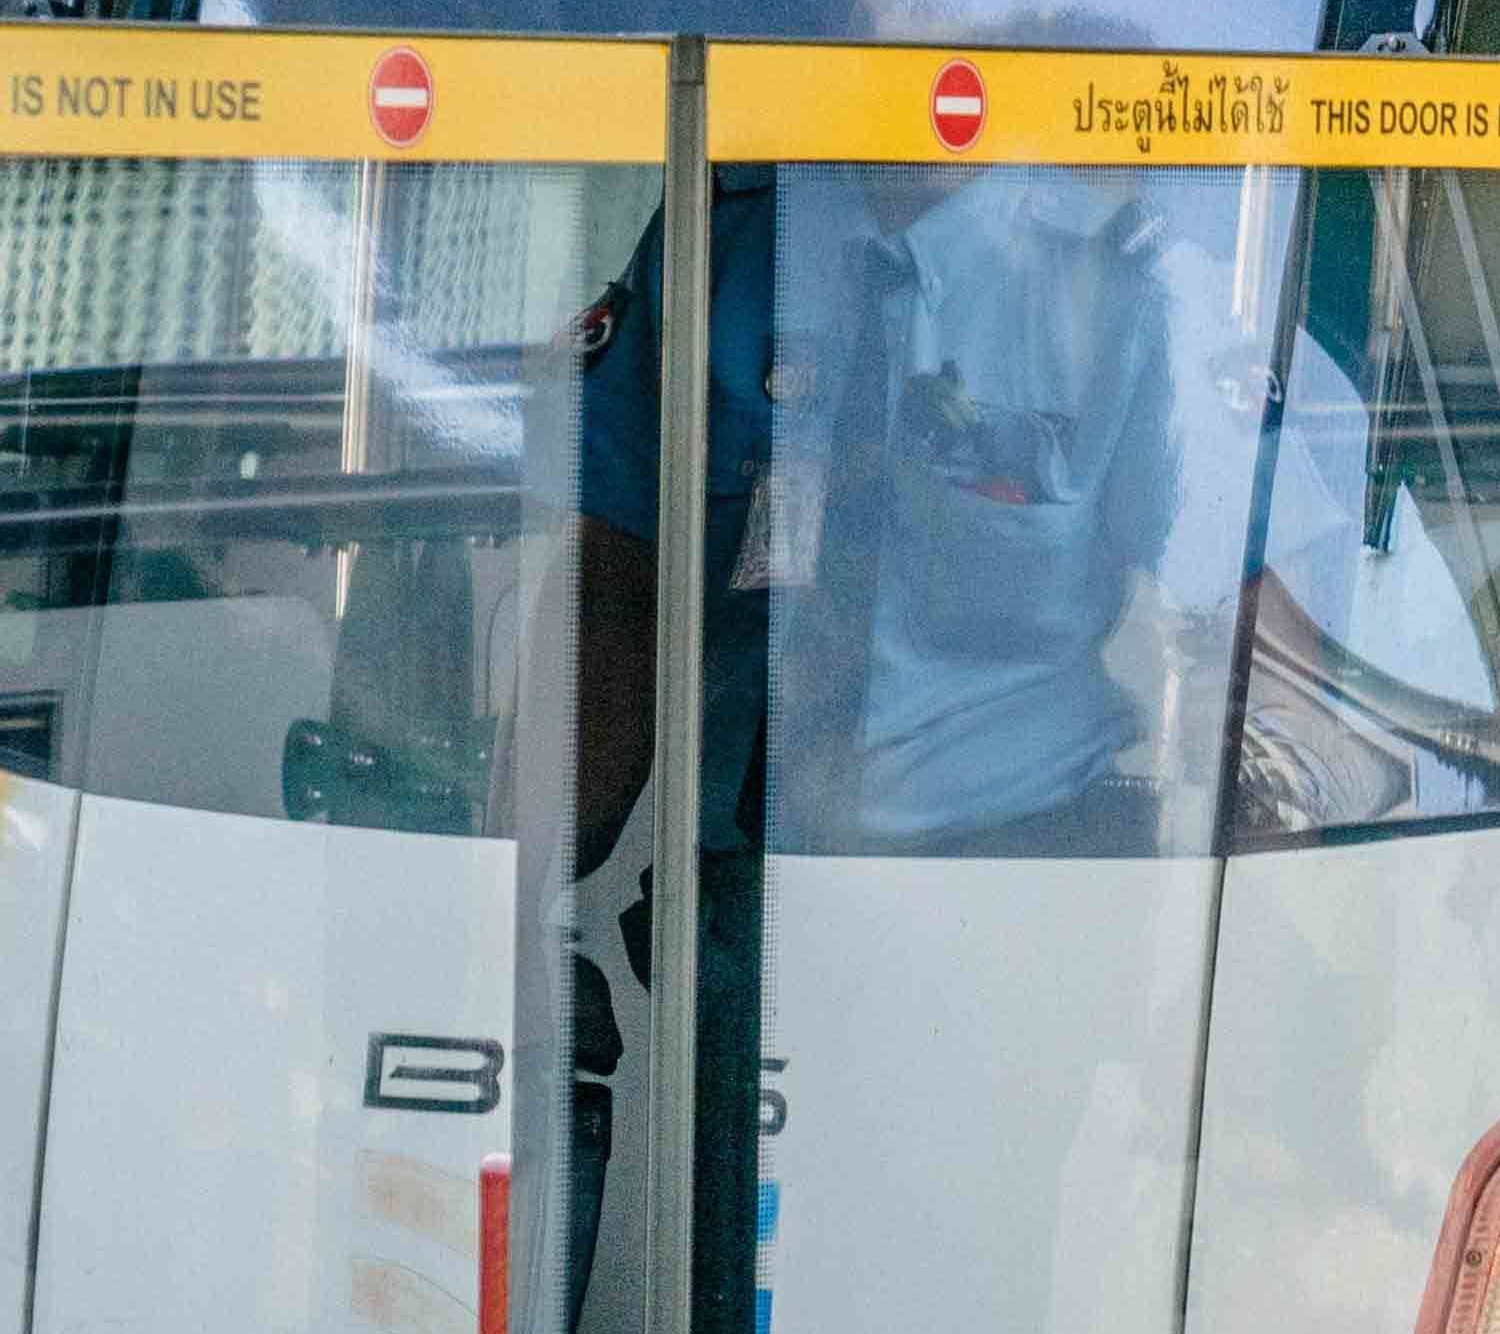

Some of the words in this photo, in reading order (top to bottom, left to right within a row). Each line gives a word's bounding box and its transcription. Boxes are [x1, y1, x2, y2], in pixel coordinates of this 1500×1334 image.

[11, 75, 44, 117] IS
[57, 76, 133, 118] NOT
[144, 79, 177, 119] IN
[191, 80, 262, 122] USE
[1311, 99, 1370, 135] THIS
[1379, 101, 1457, 137] DOOR
[1465, 103, 1489, 137] IS
